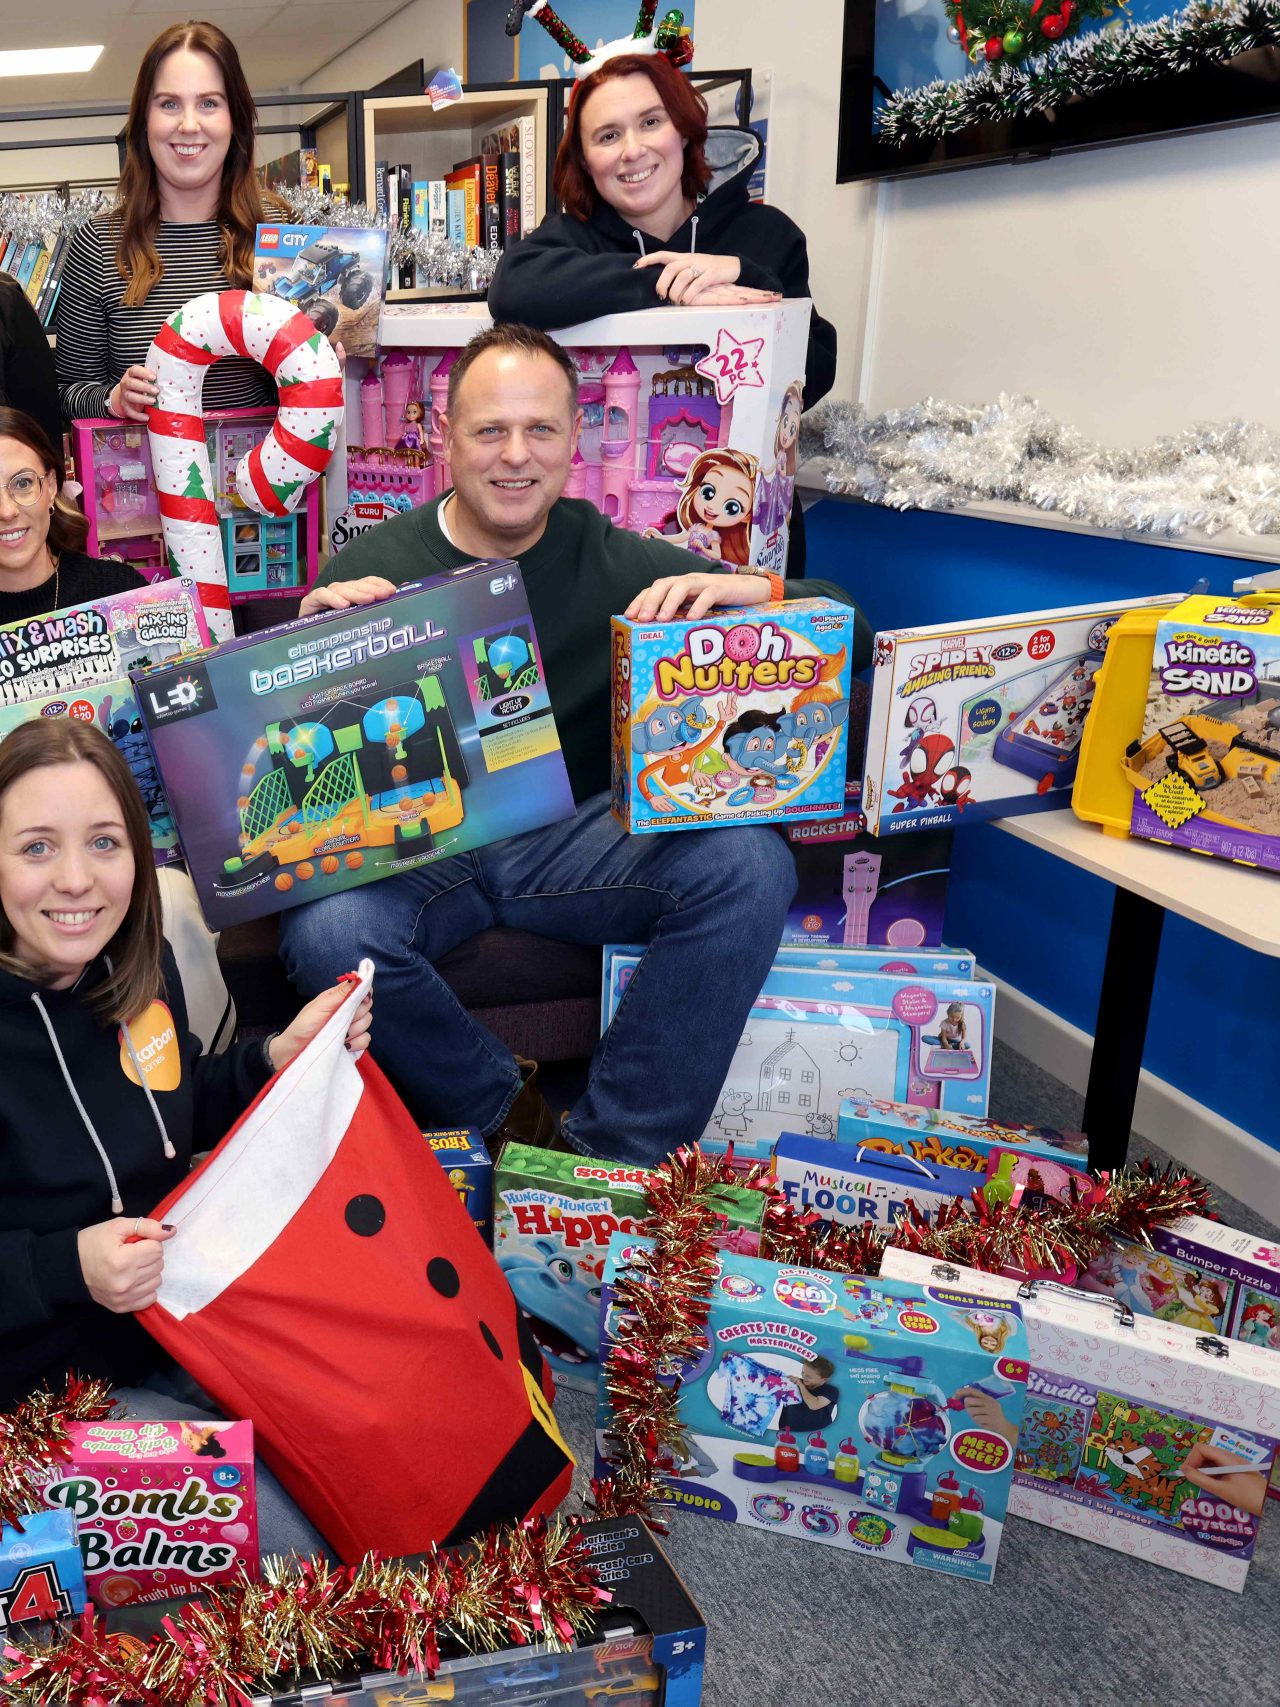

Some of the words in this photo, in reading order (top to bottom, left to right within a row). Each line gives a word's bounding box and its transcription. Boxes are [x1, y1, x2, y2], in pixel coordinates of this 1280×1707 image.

[524, 126, 534, 160] SLOW
[376, 167, 386, 197] Bernard
[485, 165, 498, 204] Deaver
[524, 164, 534, 217] COOKER
[466, 181, 475, 219] Danielle
[402, 197, 410, 228] Rankin
[261, 233, 279, 244] LEGO
[282, 234, 309, 246] CITY
[466, 219, 475, 242] Steel
[715, 347, 749, 377] 22
[728, 372, 746, 385] PC
[358, 507, 380, 516] ZURU
[489, 575, 519, 596] 6+
[824, 614, 848, 624] Players
[1216, 606, 1271, 617] Kinetic
[140, 625, 187, 639] GALORE!
[289, 617, 392, 658] championship
[639, 632, 663, 640] IDEAL
[815, 623, 832, 632] Aged
[940, 637, 966, 650] MARVEL
[1031, 643, 1052, 655] £20
[1033, 635, 1039, 644] 2
[1039, 634, 1052, 644] for
[417, 656, 452, 671] BASKETBALL
[909, 645, 995, 679] SPIDEY
[1168, 641, 1252, 666] Kinetic
[657, 657, 816, 695] Nutters
[901, 668, 952, 698] AMAZING
[951, 663, 996, 682] FRIENDS
[149, 681, 197, 714] LED
[972, 717, 997, 728] SOUNDS
[975, 706, 996, 717] LIGHTS
[636, 819, 650, 827] The
[650, 813, 712, 825] ELEFANTASTIC
[714, 812, 735, 821] Game
[746, 809, 773, 819] Picking
[785, 803, 842, 815] DOUGHNUTS!
[890, 818, 917, 831] SUPER
[919, 813, 953, 827] PINBALL
[959, 962, 969, 970] 3+
[803, 1168, 872, 1196] Musical
[504, 1191, 555, 1205] HUNGRY
[557, 1198, 609, 1213] HUNGRY
[782, 1180, 881, 1220] FLOOR
[1176, 1246, 1228, 1276] Bumper
[1229, 1264, 1273, 1290] Puzzle
[937, 1293, 975, 1305] STUDIO
[976, 1298, 1013, 1310] DESIGN
[717, 1321, 765, 1342] CREATE
[766, 1321, 788, 1336] TIE
[789, 1325, 817, 1347] DYE
[749, 1336, 816, 1361] MASTERPIECES!
[1004, 1362, 1023, 1374] 6+
[1025, 1371, 1097, 1407] Studio
[87, 1427, 134, 1442] Balms
[1218, 1433, 1260, 1457] Colour
[82, 1441, 134, 1457] Bombs
[957, 1447, 1000, 1469] FREE!
[961, 1436, 1004, 1458] MESS
[219, 1471, 235, 1481] 8+
[43, 1477, 243, 1523] Bombs
[664, 1489, 722, 1512] STUDIO
[1017, 1476, 1062, 1495] pictures
[1062, 1488, 1084, 1503] and
[1095, 1498, 1115, 1513] big
[1115, 1507, 1154, 1526] poster
[1181, 1498, 1252, 1524] 4000
[1181, 1514, 1255, 1537] crystals
[80, 1530, 236, 1576] Balms
[628, 1553, 654, 1568] Cars
[932, 1552, 976, 1568] WARNING:
[7, 1571, 64, 1625] 4
[138, 1587, 168, 1607] fruity
[169, 1583, 187, 1599] lip
[614, 1640, 634, 1651] STOP
[672, 1640, 696, 1656] 3+
